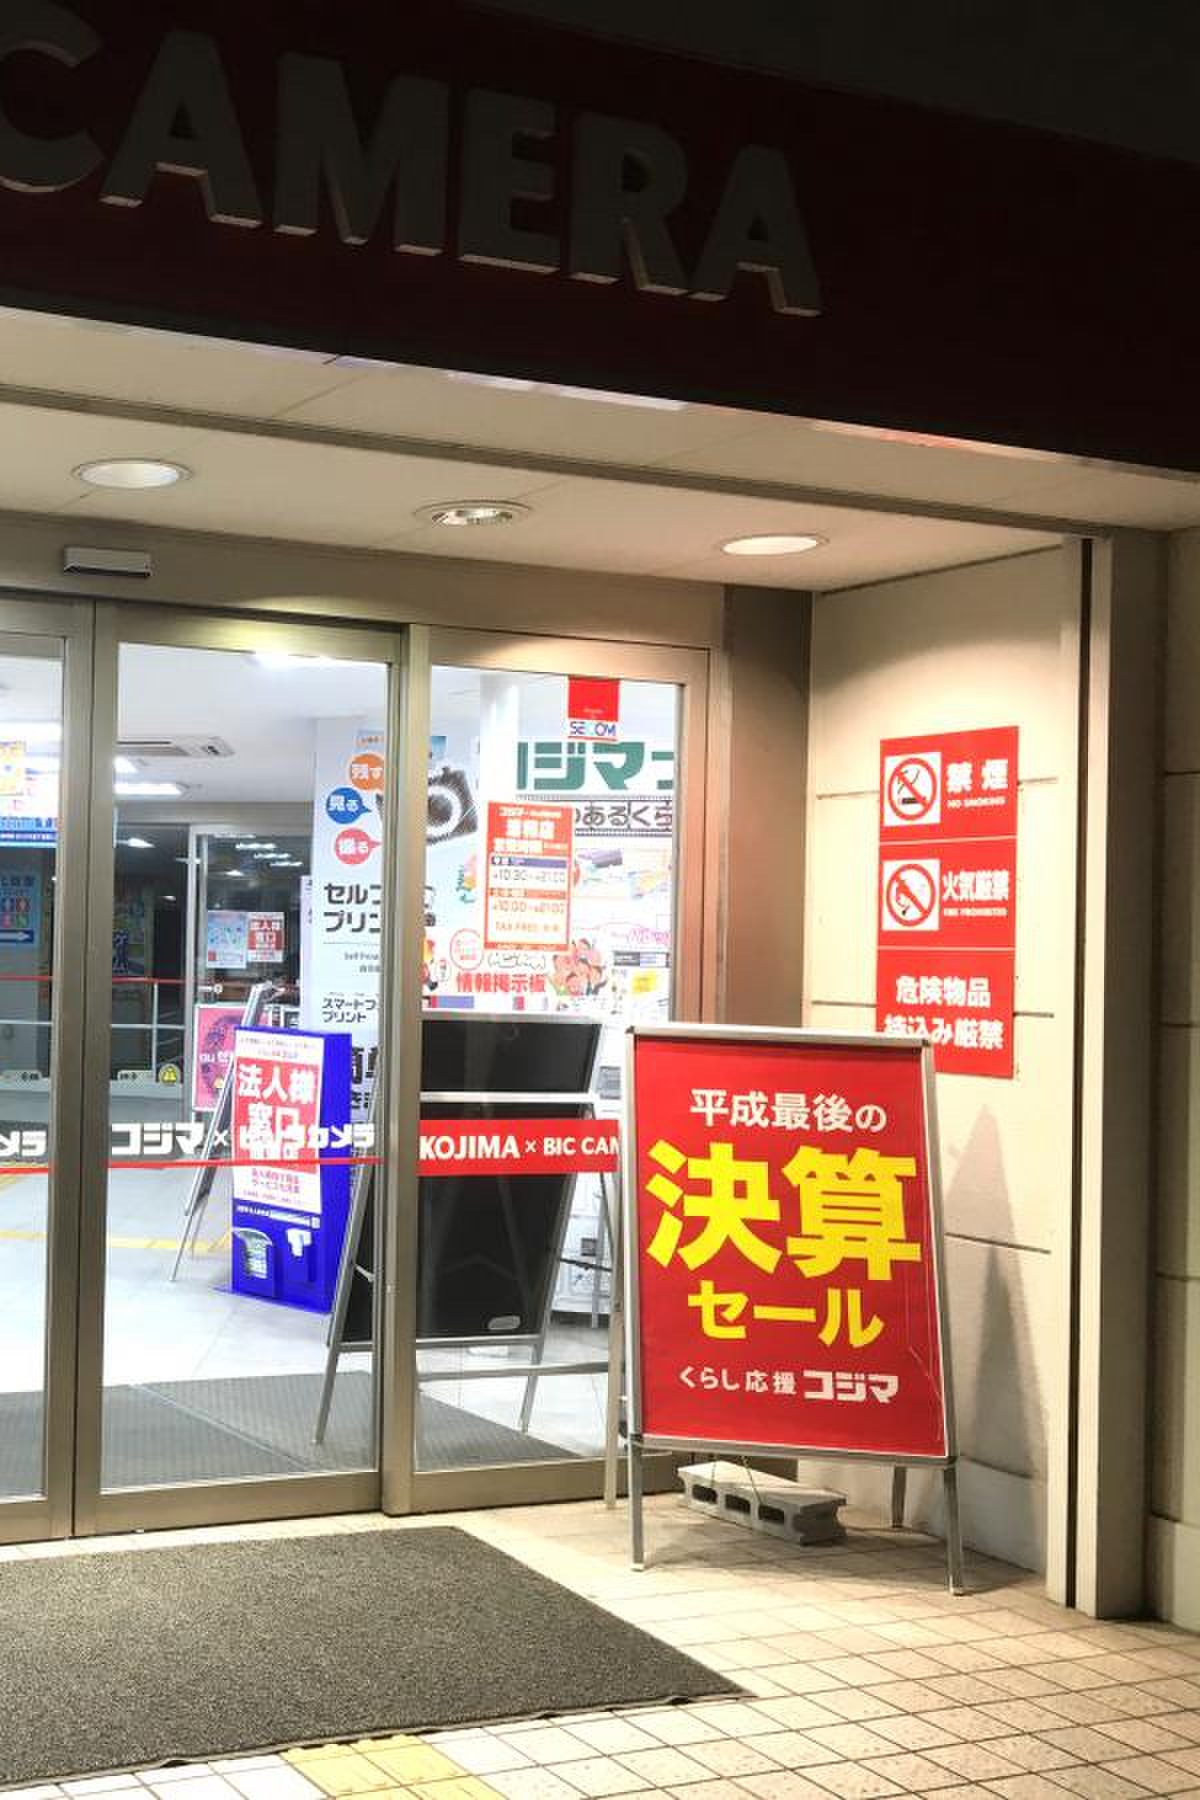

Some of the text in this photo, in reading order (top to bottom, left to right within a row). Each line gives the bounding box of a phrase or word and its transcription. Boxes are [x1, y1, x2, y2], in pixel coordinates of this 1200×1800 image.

[895, 975, 992, 1008] 危険物品
[690, 1087, 887, 1133] 平成最後の
[111, 1122, 205, 1155] コジマ
[419, 1135, 520, 1161] KOJIMA
[543, 1136, 577, 1156] BIC
[645, 1138, 922, 1282] 決算
[687, 1280, 885, 1349] セール
[803, 1369, 899, 1404] コジマ
